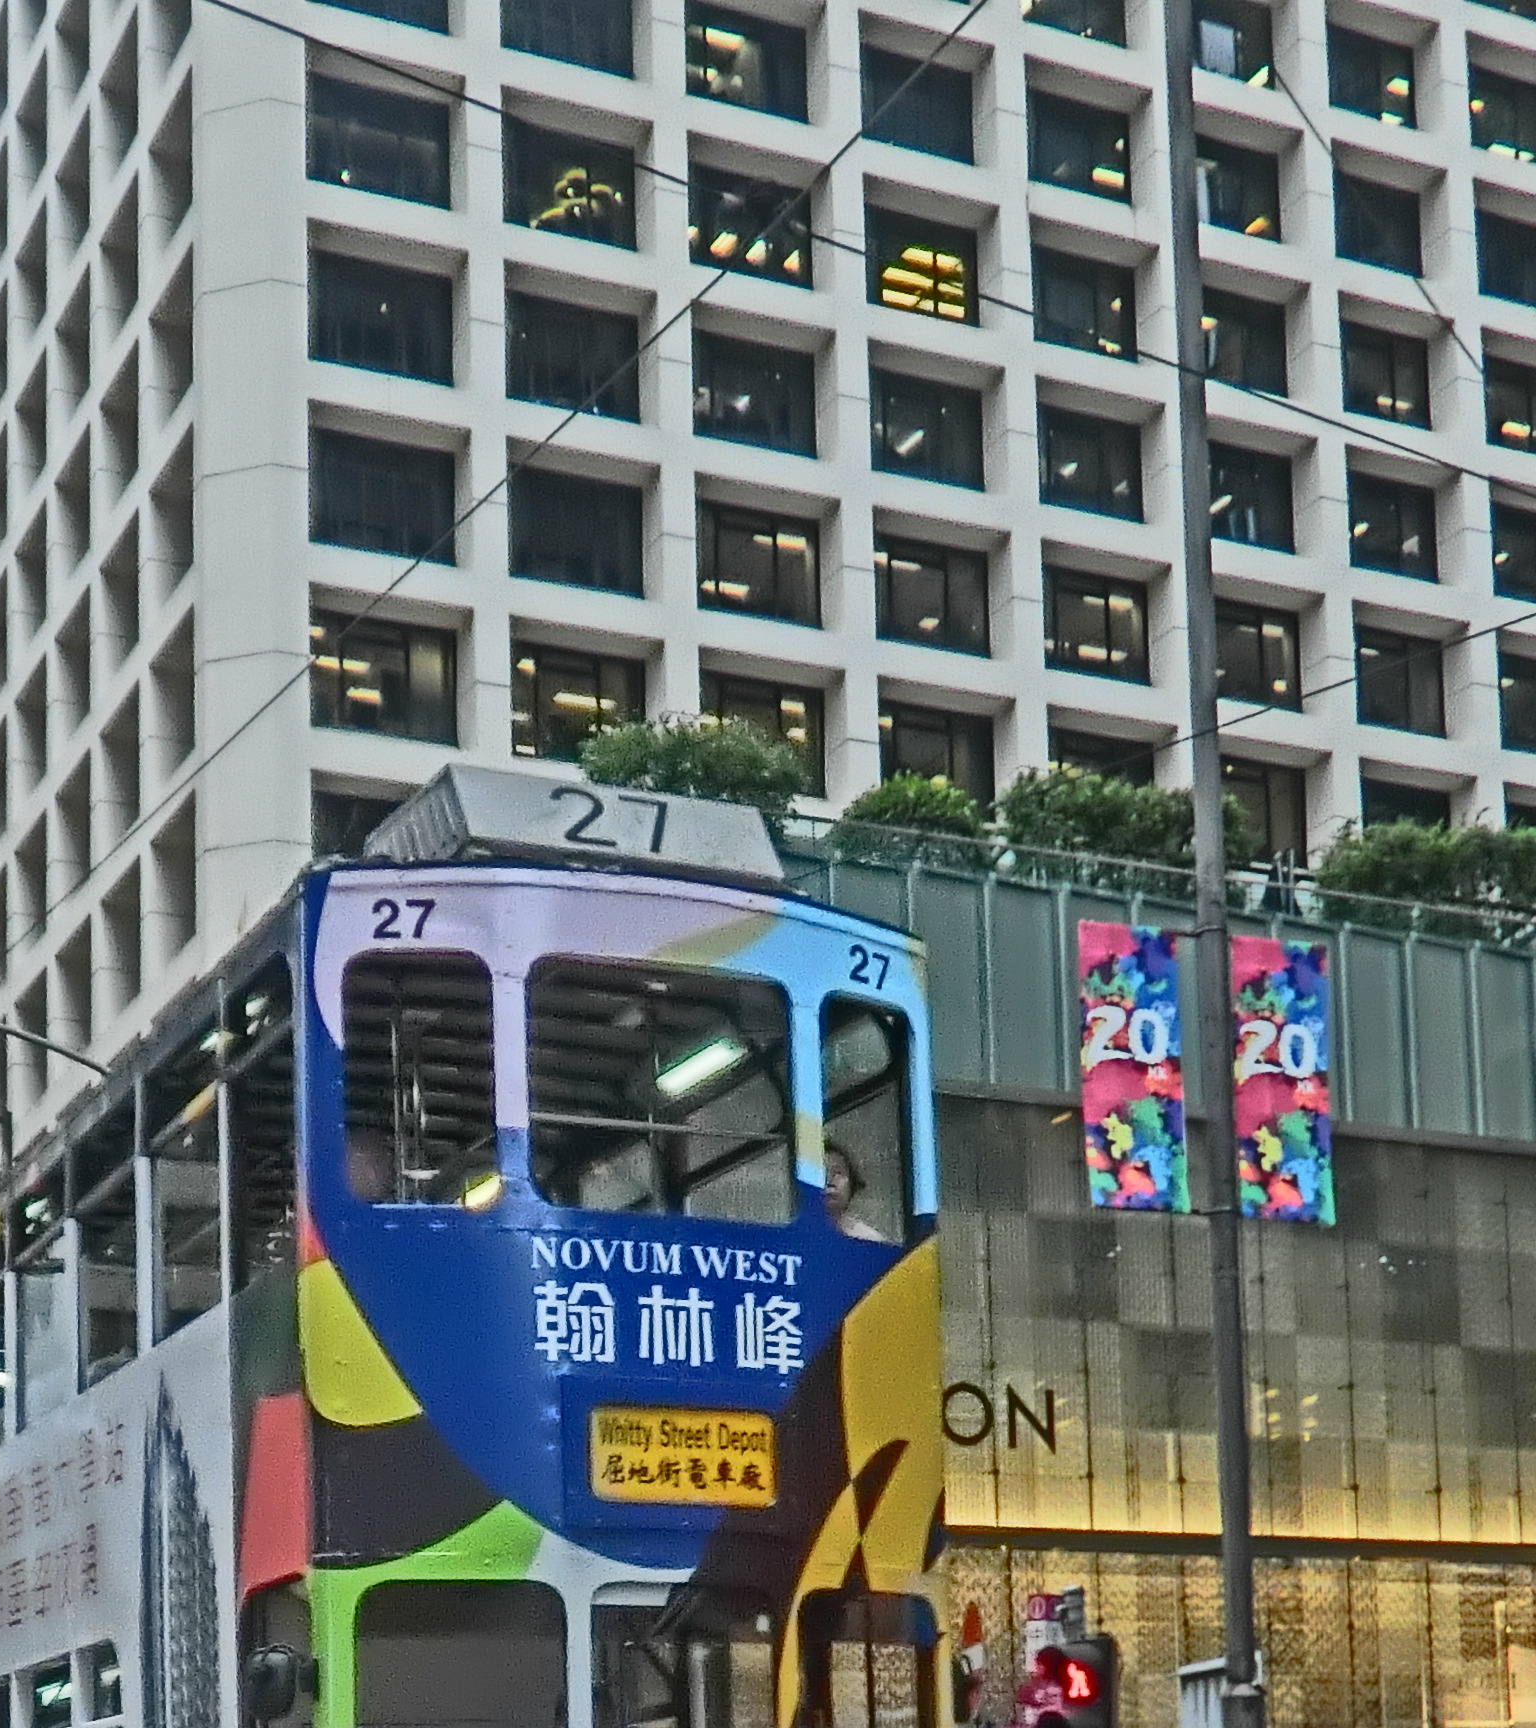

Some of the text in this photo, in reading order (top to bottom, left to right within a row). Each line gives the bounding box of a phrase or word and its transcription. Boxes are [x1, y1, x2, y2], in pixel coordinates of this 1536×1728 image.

[550, 787, 669, 853] 27
[372, 899, 436, 939] 27
[849, 944, 892, 990] 27
[1085, 1006, 1169, 1065] 20
[1239, 1020, 1317, 1079] 20
[530, 1236, 803, 1286] NOVUM WEST
[533, 1279, 805, 1375] 翰林峰
[598, 1415, 767, 1456] Whitty Street Depot
